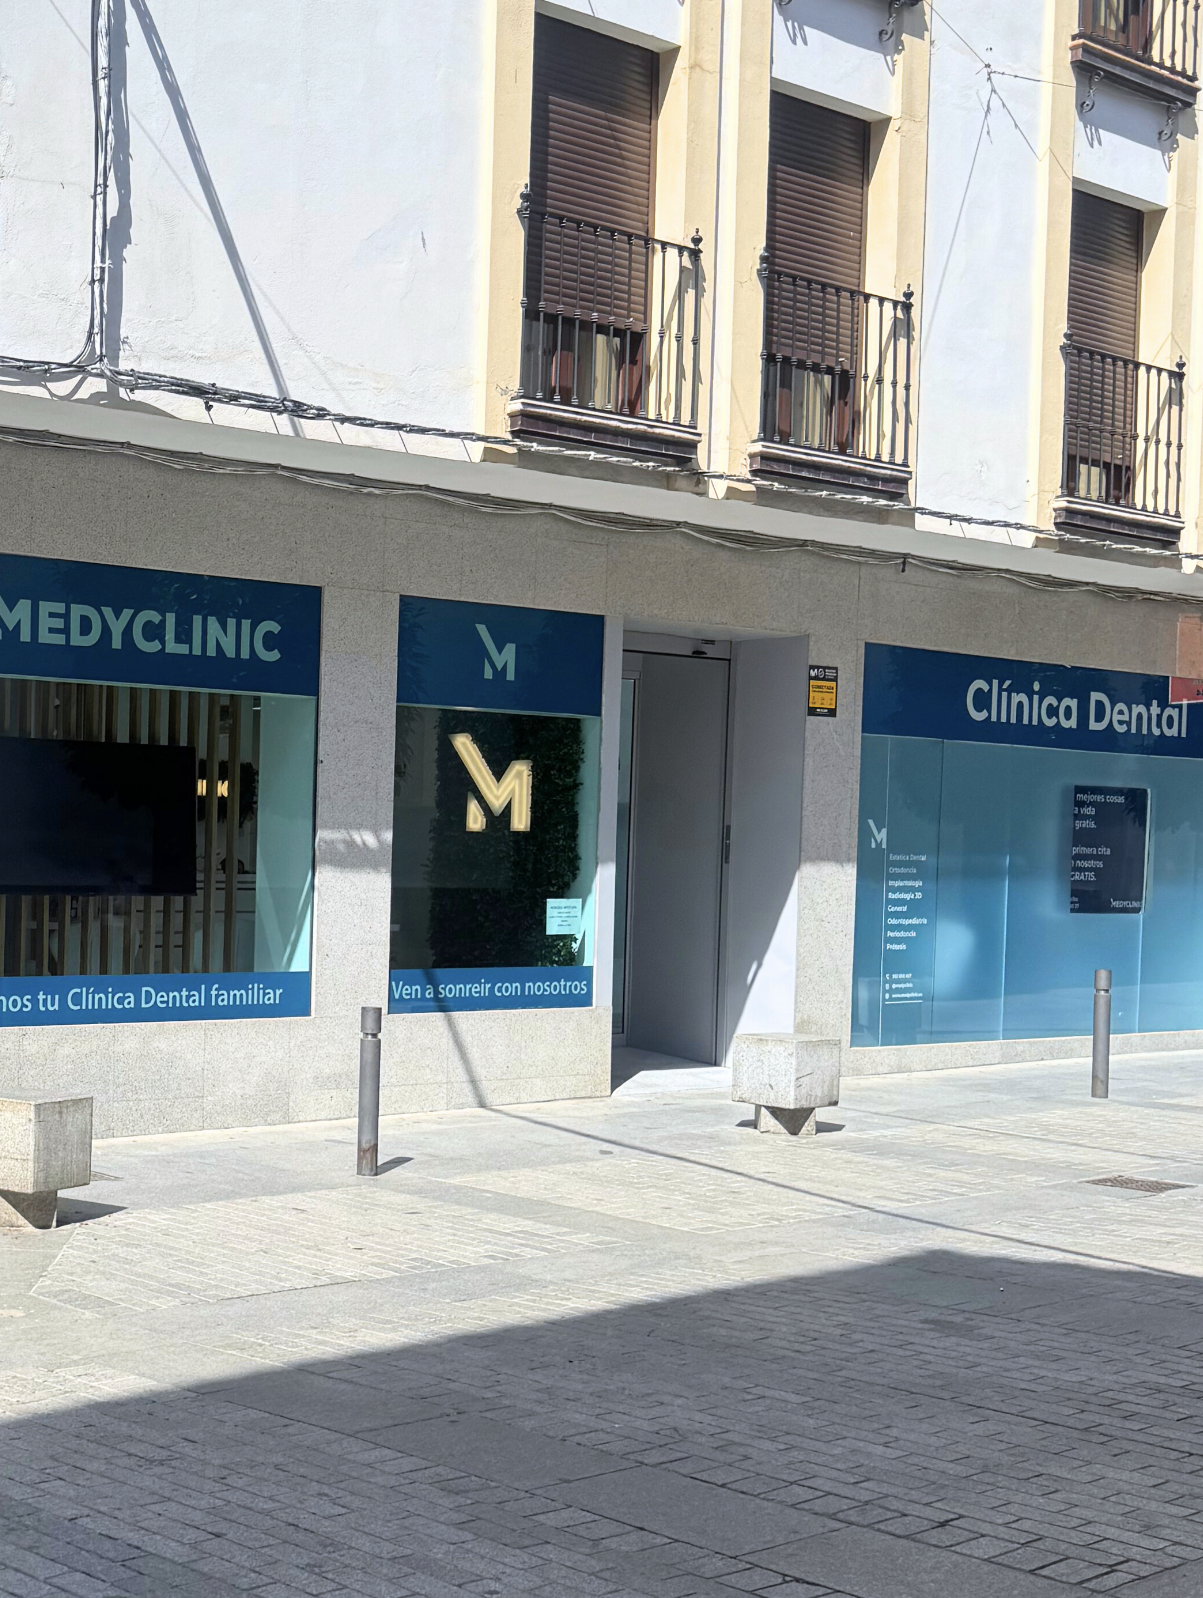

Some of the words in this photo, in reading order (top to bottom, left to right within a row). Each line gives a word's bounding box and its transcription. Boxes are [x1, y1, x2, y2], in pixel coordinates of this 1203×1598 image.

[966, 679, 1078, 728] Clínica
[1088, 691, 1188, 738] Dental
[1076, 791, 1105, 803] mejores
[1106, 795, 1125, 803] cosas
[1080, 805, 1095, 814] vida
[1075, 818, 1097, 830] gratis.
[1072, 845, 1096, 855] primera
[1097, 845, 1111, 855] cita
[1075, 860, 1103, 868] nosotros
[1070, 872, 1097, 881] GRATIS.
[392, 981, 421, 999] Ven
[425, 984, 434, 998] a
[438, 979, 491, 998] sonreir
[494, 982, 521, 996] con
[524, 979, 588, 995] nosotros
[38, 990, 59, 1011] tu
[67, 986, 135, 1010] Clínica
[141, 985, 205, 1009] Dental
[210, 983, 283, 1006] familiar
